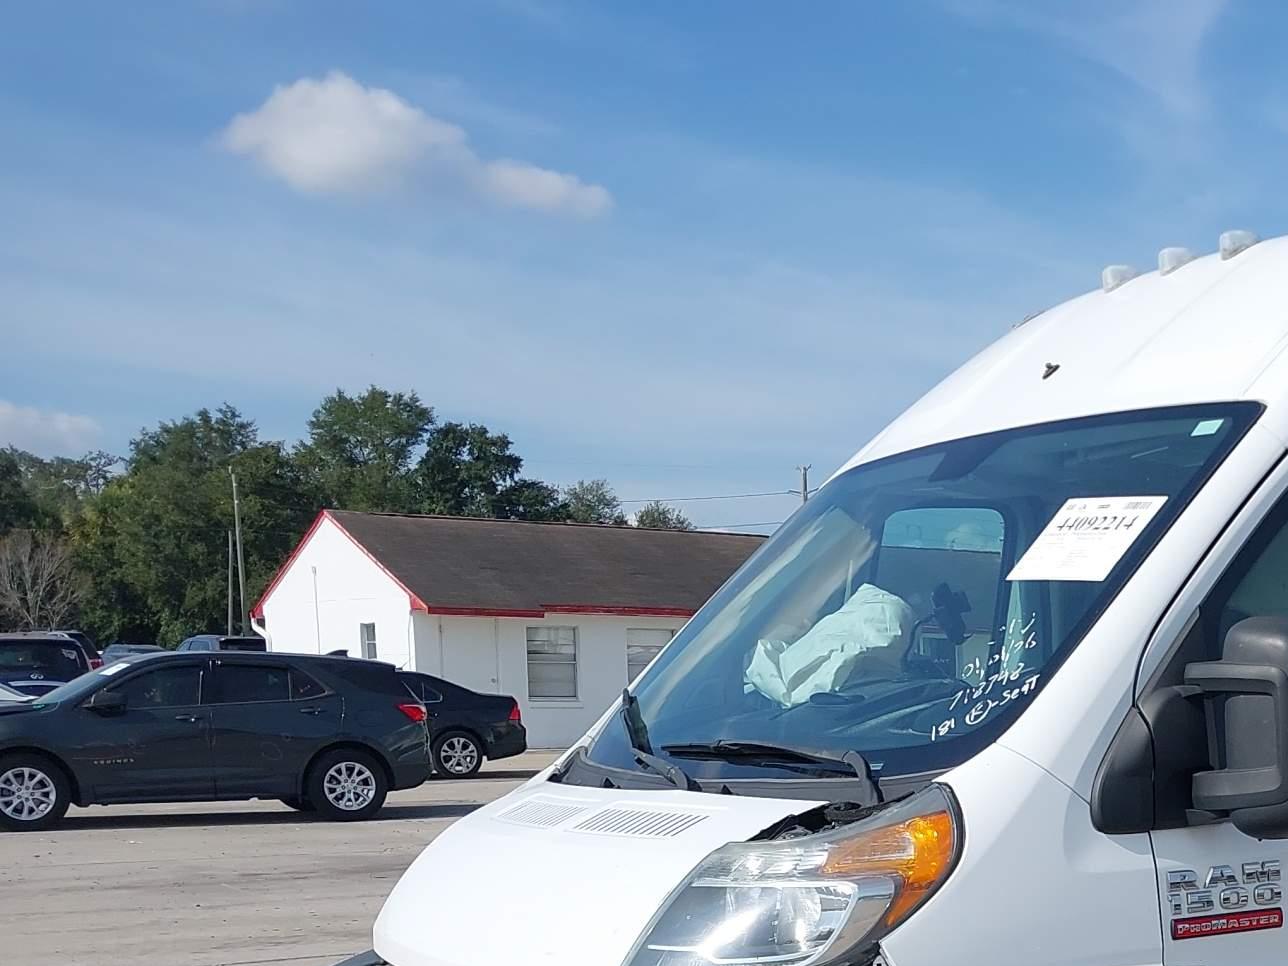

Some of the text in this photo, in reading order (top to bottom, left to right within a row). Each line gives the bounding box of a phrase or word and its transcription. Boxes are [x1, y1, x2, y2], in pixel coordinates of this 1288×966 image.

[1056, 514, 1140, 531] 44092214
[1167, 859, 1282, 893] RAM
[1167, 882, 1282, 916] 1500
